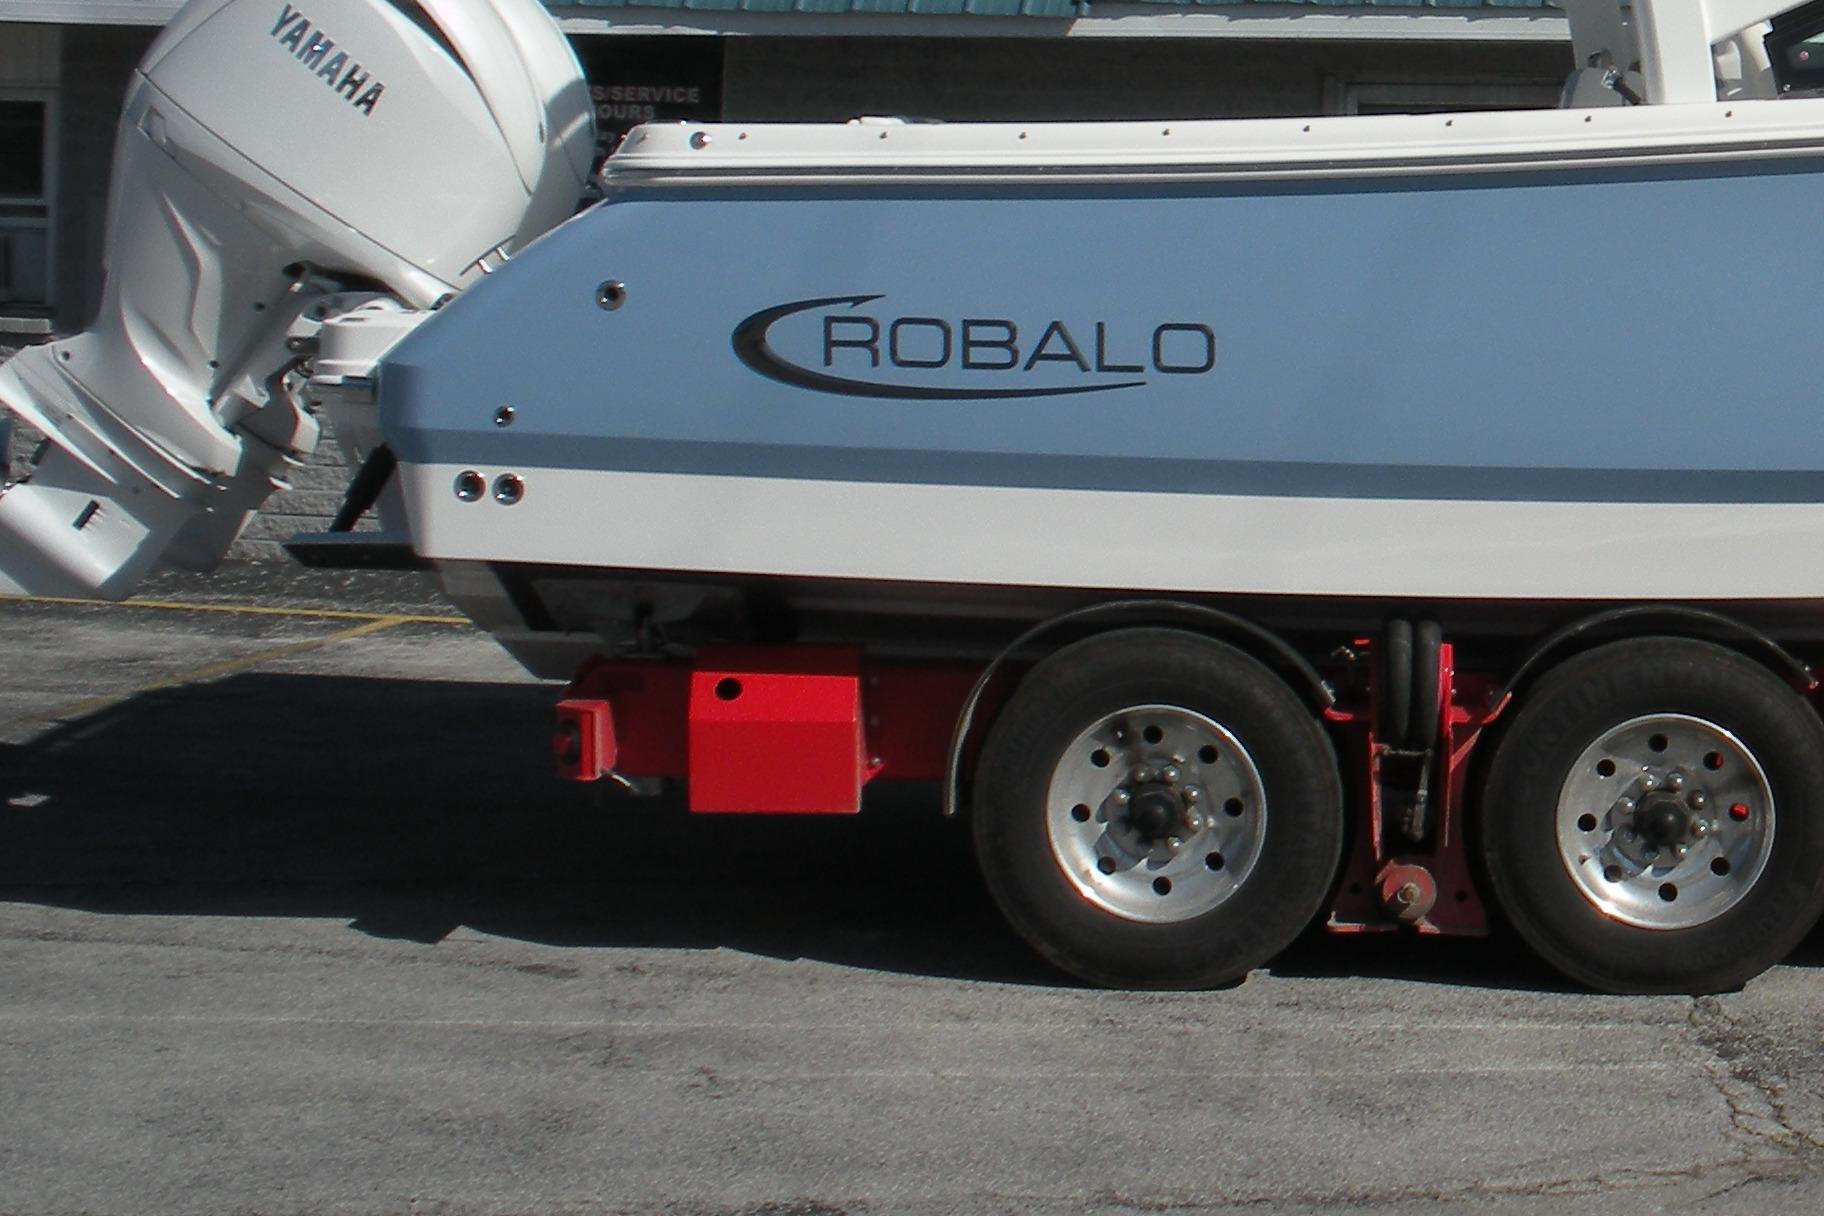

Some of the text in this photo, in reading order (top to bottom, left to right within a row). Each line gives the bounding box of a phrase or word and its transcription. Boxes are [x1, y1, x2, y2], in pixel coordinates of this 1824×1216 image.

[269, 3, 386, 117] YAMAHA
[591, 85, 700, 103] S/SERVICE
[598, 103, 655, 121] OURS
[823, 315, 1217, 374] ROBALO
